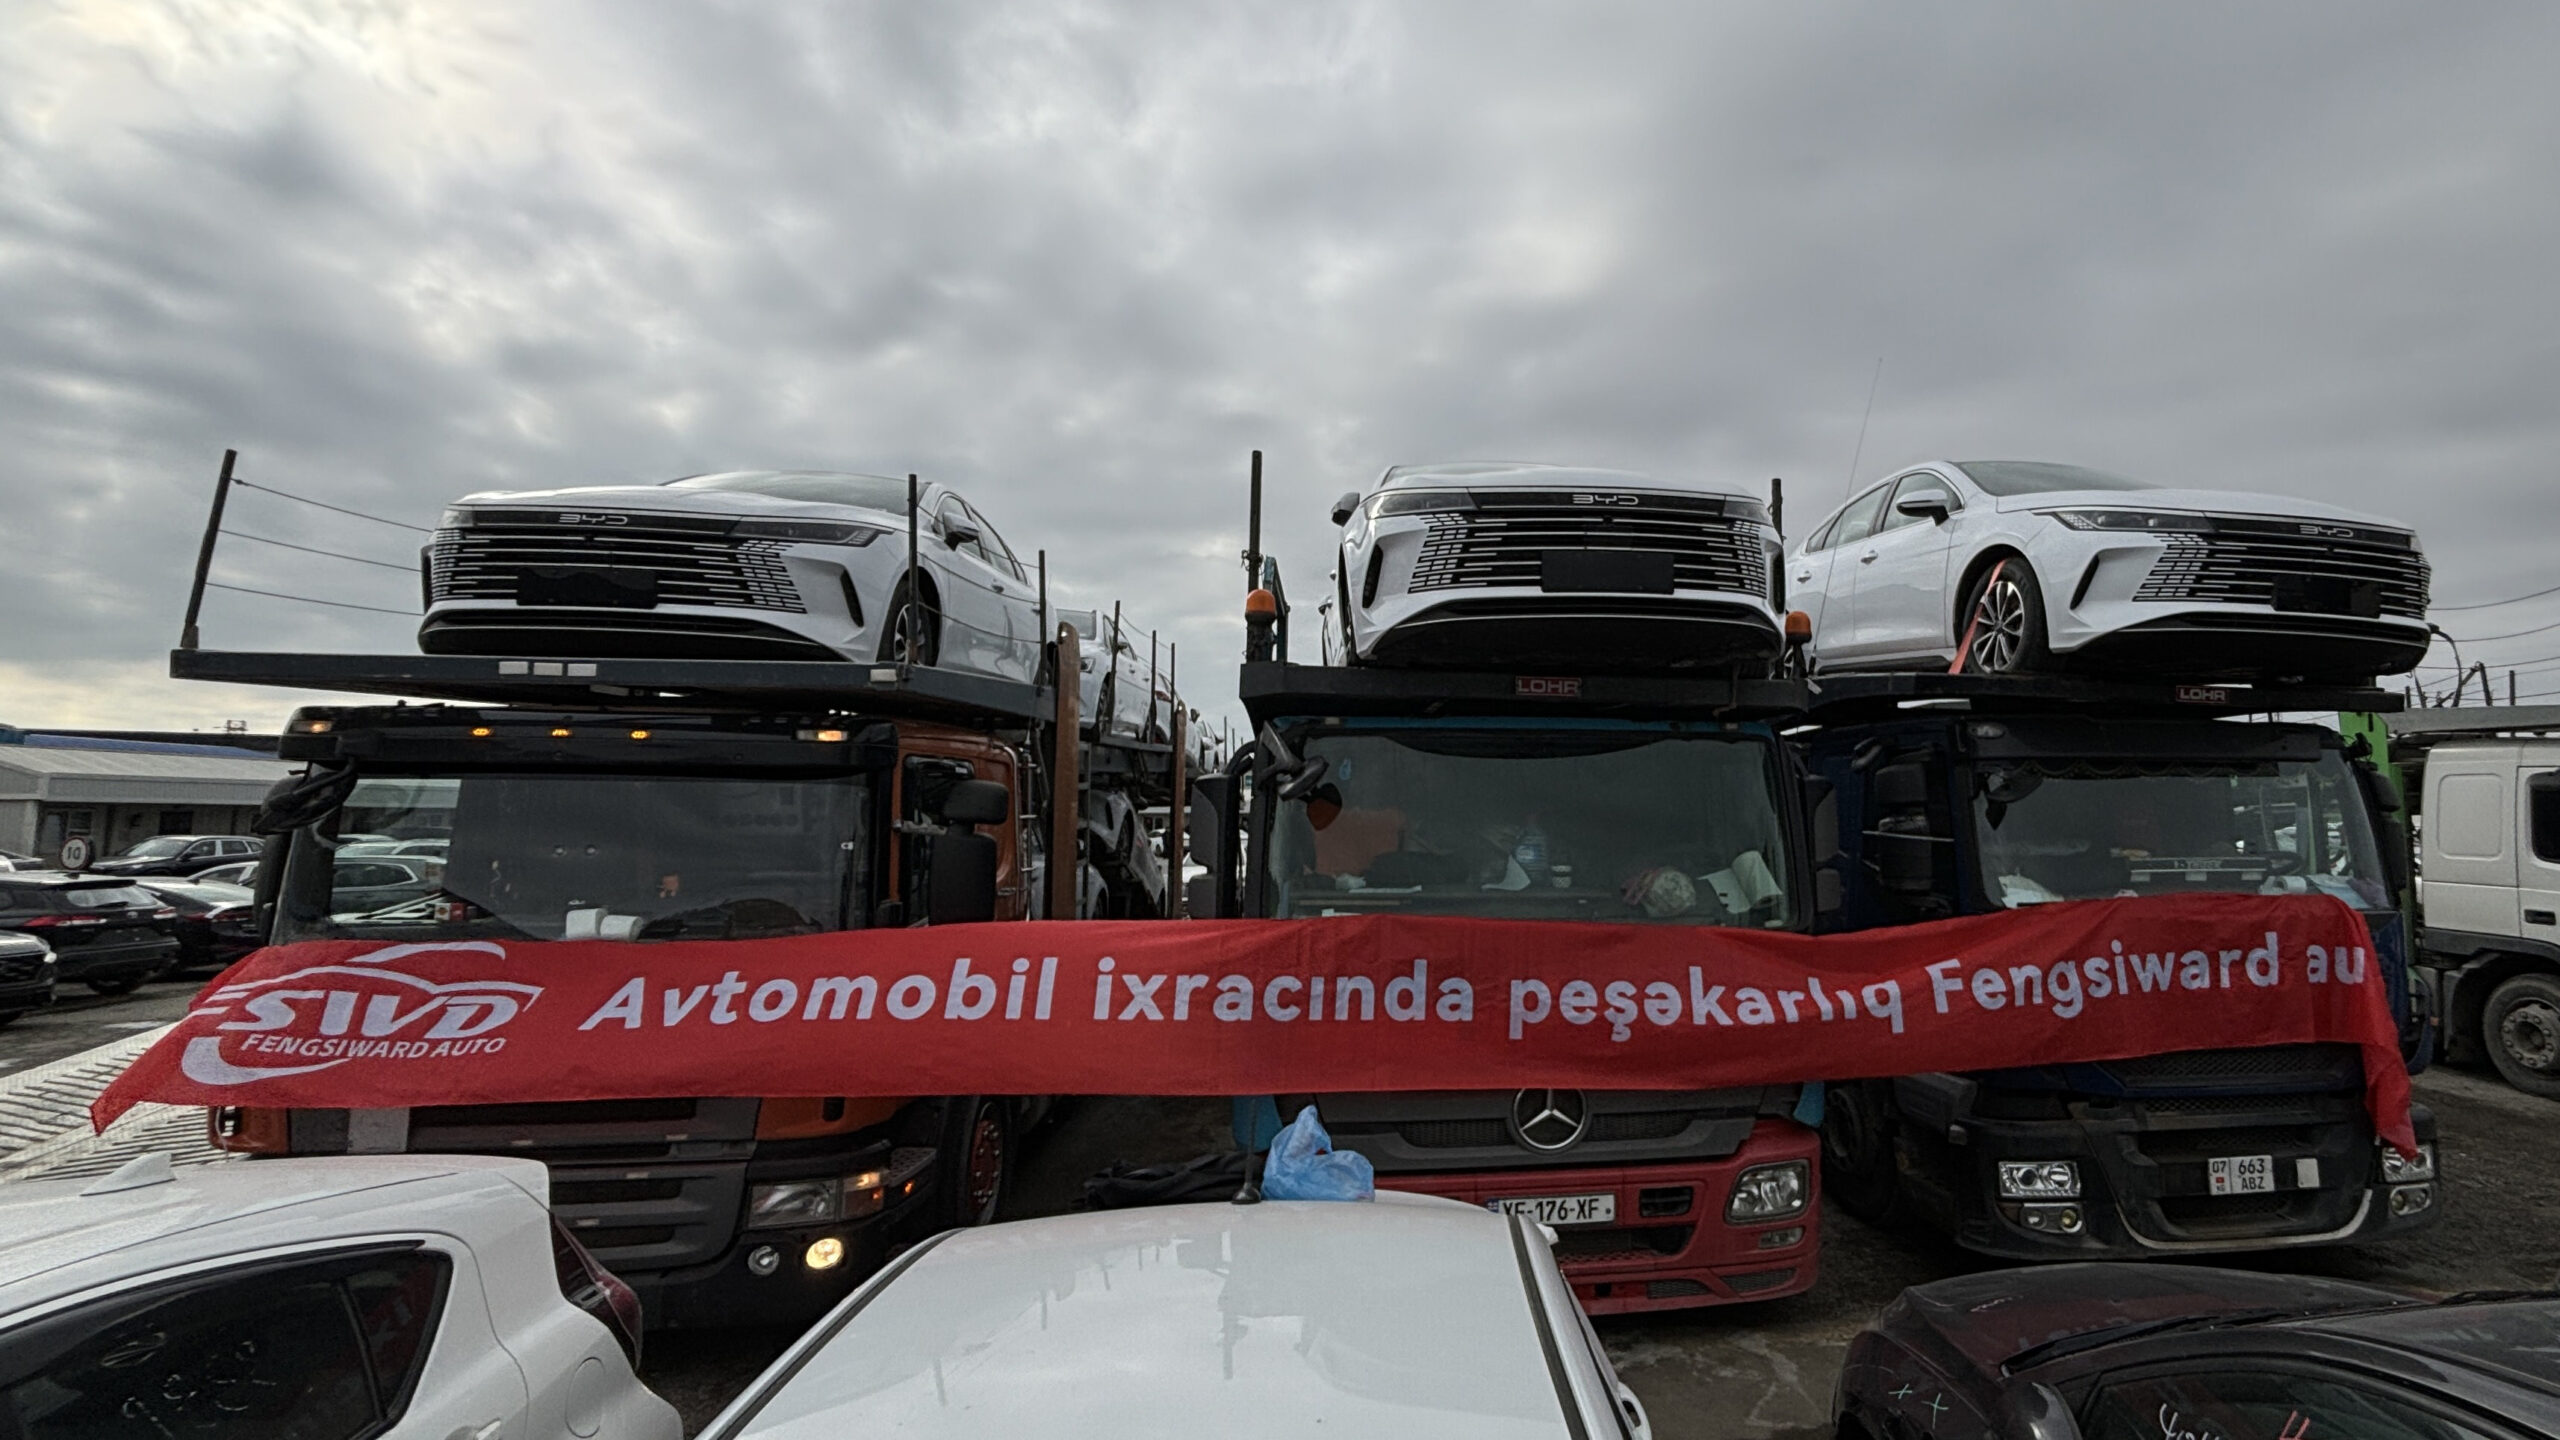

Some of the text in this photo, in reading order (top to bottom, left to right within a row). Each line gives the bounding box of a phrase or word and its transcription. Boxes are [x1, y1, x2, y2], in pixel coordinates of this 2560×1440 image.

[1572, 494, 1639, 506] BYD
[559, 513, 629, 525] BYD
[2299, 525, 2354, 538] BYD
[1517, 679, 1580, 694] LOHR
[2180, 688, 2226, 701] LOHR
[67, 846, 82, 860] 10
[577, 931, 2366, 1042] Avtomobil ixracında peşəkarlıq Fengsiward au
[240, 1034, 507, 1059] FENGSIWARD AUTO
[2212, 1161, 2226, 1173] 07
[2238, 1158, 2265, 1175] 663
[2241, 1176, 2265, 1190] ABZ
